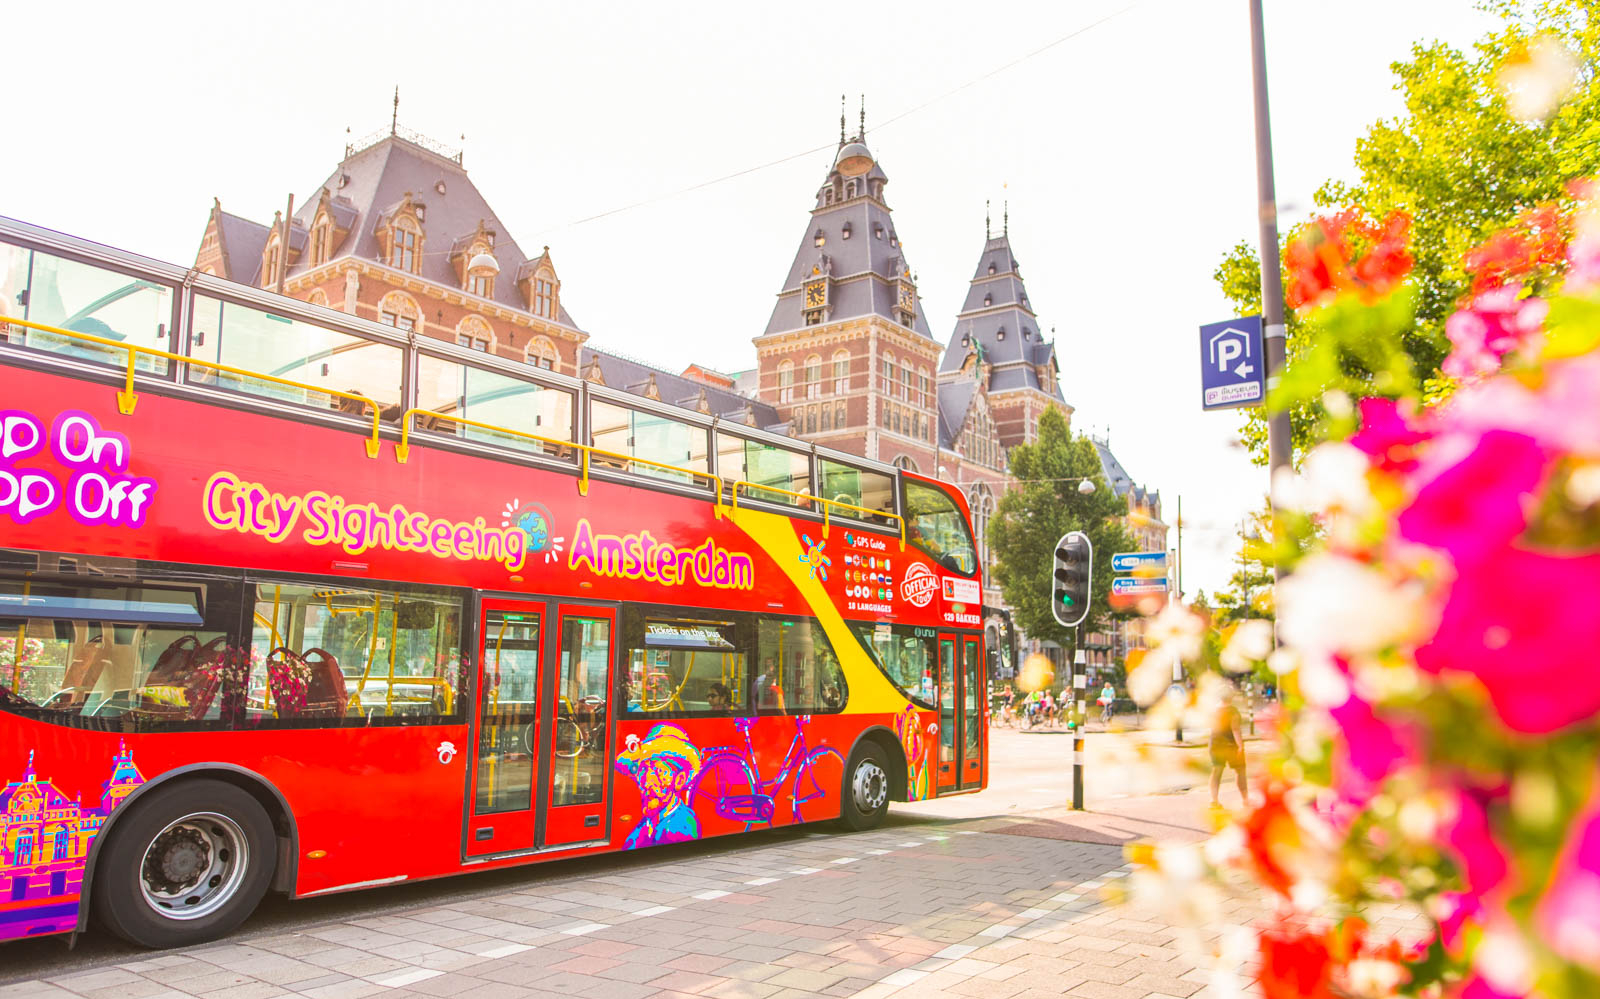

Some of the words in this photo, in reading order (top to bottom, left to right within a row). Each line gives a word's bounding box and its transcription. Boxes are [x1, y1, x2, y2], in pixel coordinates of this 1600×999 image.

[1217, 339, 1242, 372] P
[59, 416, 124, 467] On
[75, 472, 152, 522] Off
[856, 536, 869, 548] GPS
[870, 539, 886, 551] Guide
[569, 518, 754, 590] Amsterdam
[904, 576, 938, 596] OFFICIAL
[848, 601, 857, 610] 18
[857, 602, 892, 613] LANGUAGES
[956, 613, 981, 624] BAKKER
[648, 625, 679, 636] Tickets
[680, 628, 691, 637] on
[691, 627, 705, 637] the
[705, 629, 720, 638] bus
